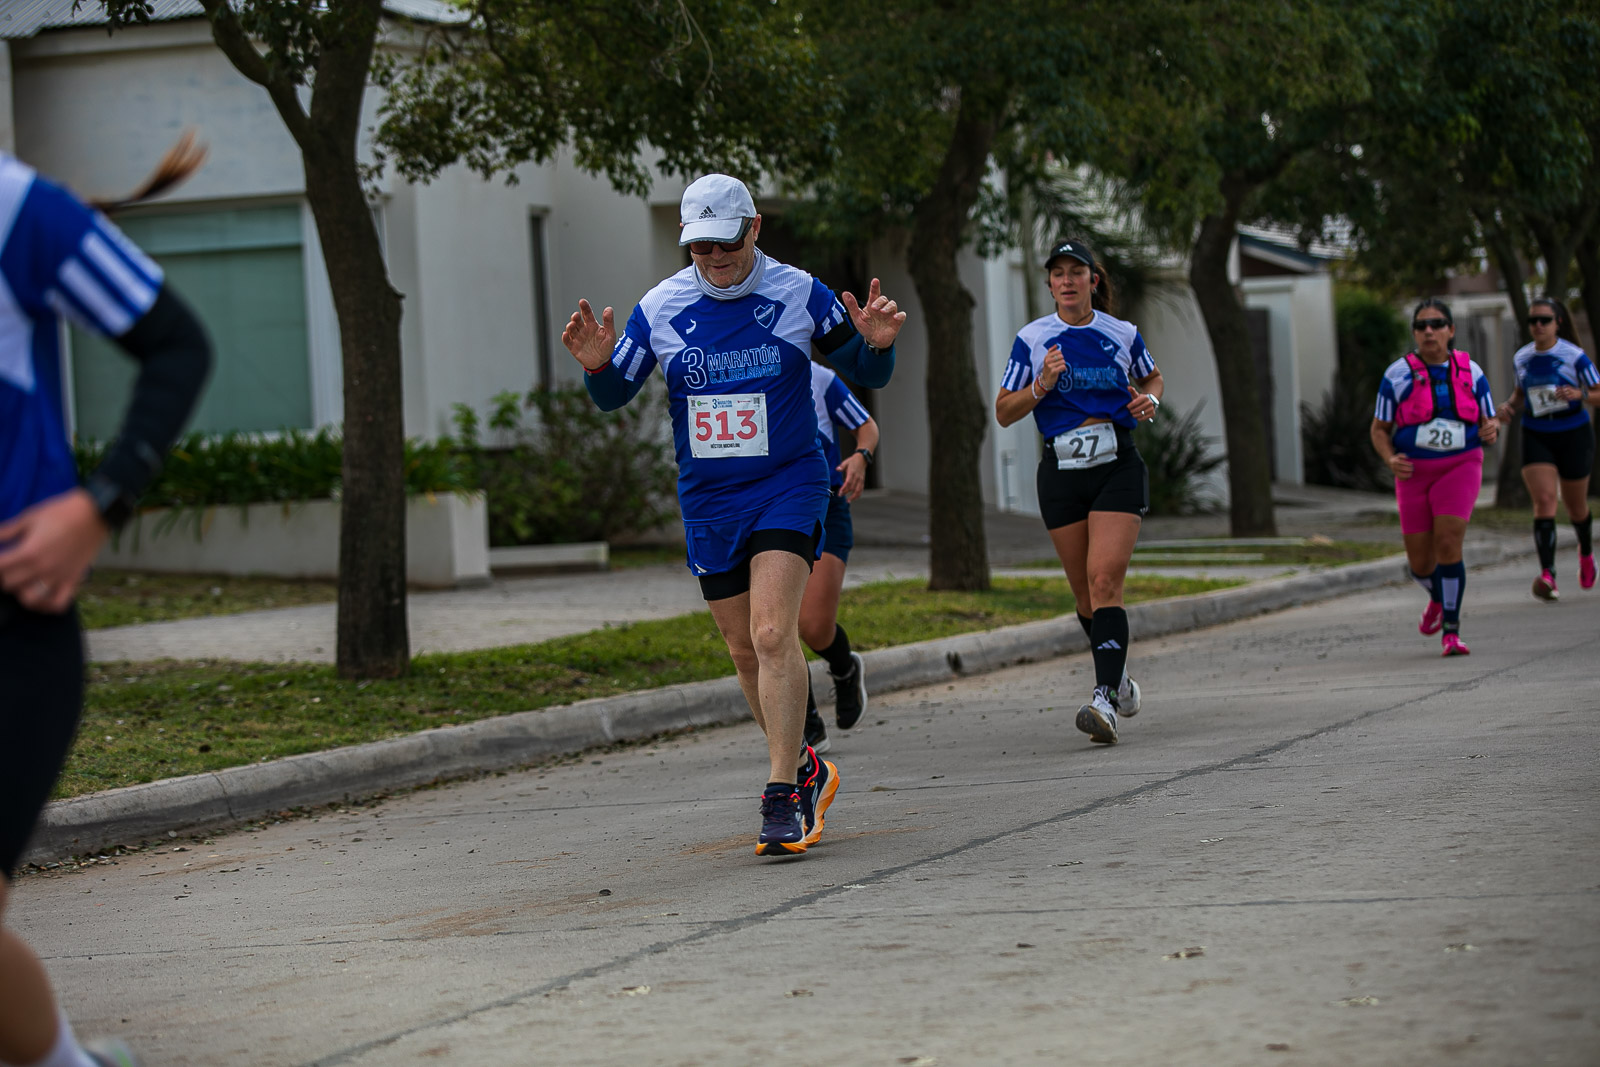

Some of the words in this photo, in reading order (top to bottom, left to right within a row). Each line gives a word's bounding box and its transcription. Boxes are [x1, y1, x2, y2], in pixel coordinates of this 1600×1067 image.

[682, 347, 707, 389] 3
[707, 344, 781, 372] MARATÓN
[696, 410, 758, 441] 513
[1428, 429, 1453, 447] 28
[1069, 435, 1100, 459] 27
